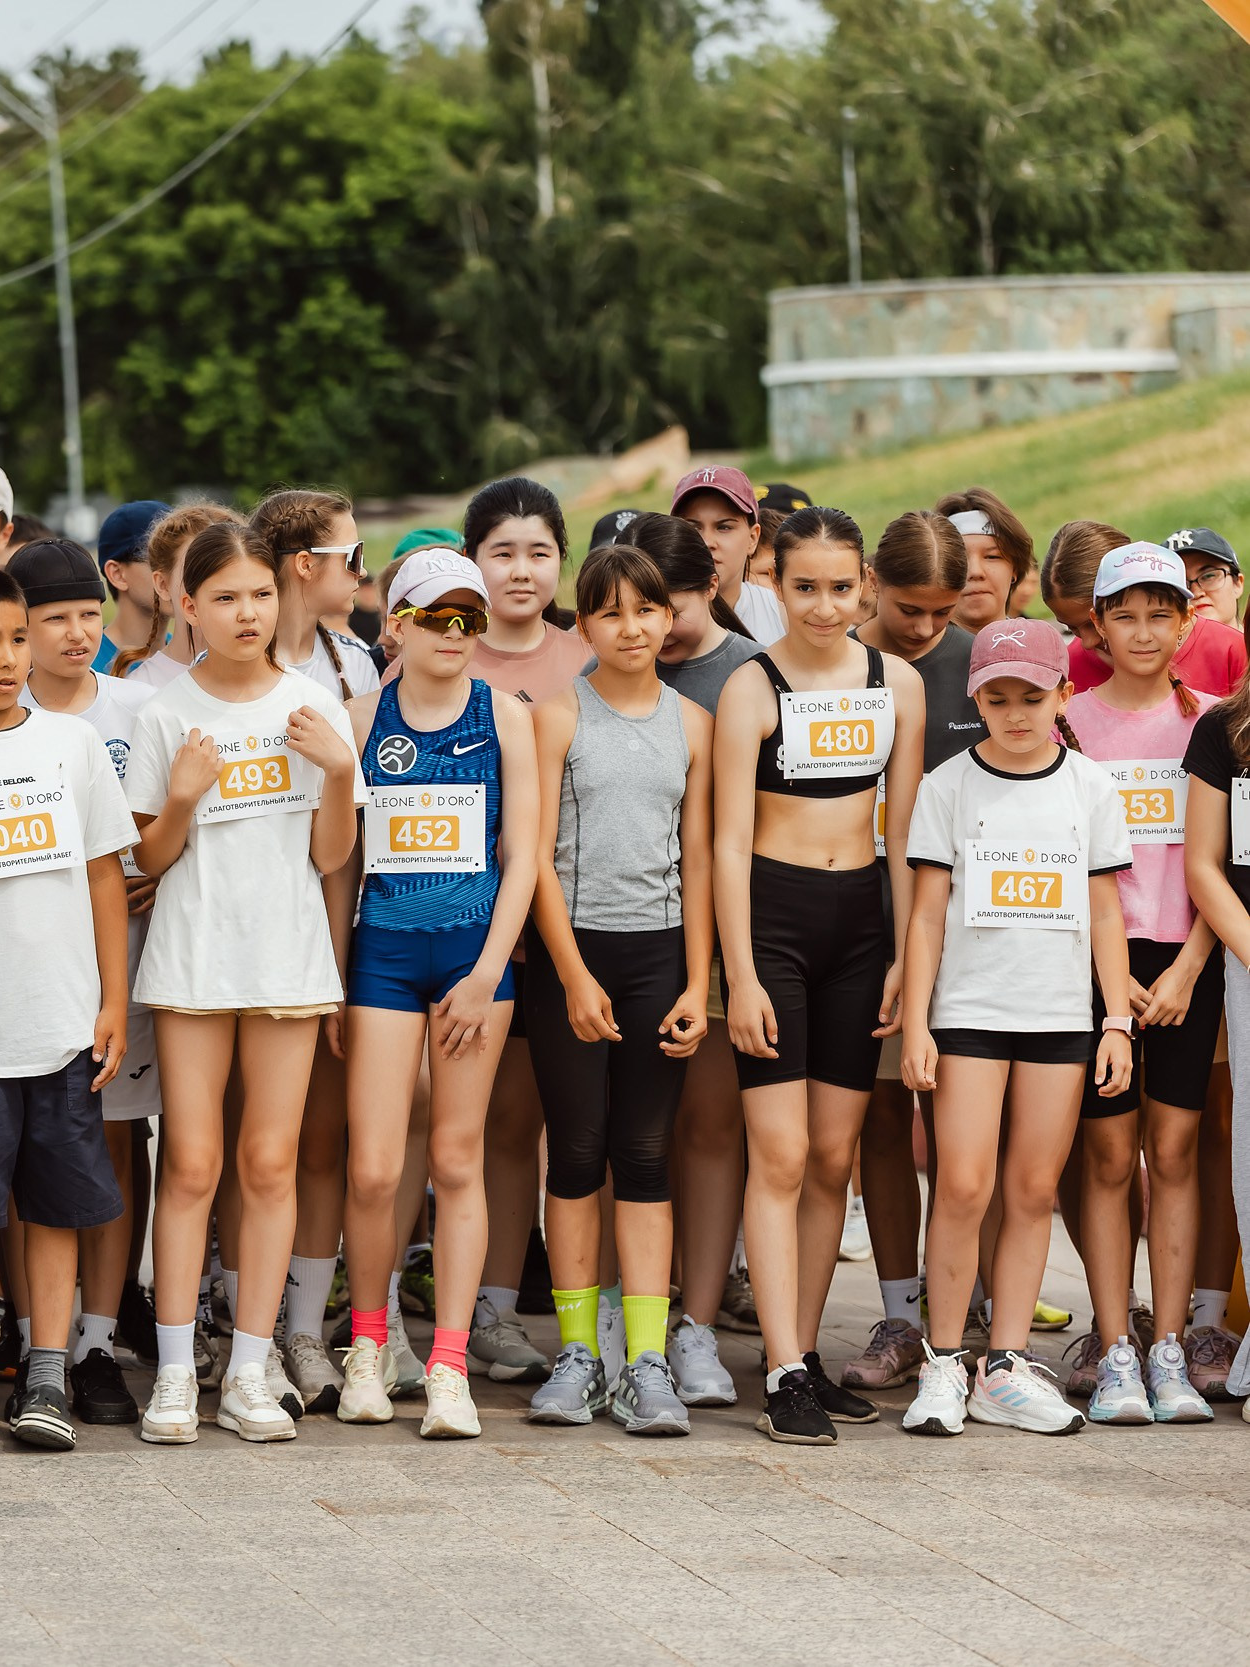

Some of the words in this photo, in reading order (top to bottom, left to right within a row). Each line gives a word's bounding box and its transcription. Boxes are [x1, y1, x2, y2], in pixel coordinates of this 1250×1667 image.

[792, 702, 834, 713] LEONE
[855, 699, 886, 711] D'ORO
[816, 724, 869, 752] 480
[226, 761, 283, 793] 493
[27, 791, 63, 805] D'ORO
[208, 796, 285, 813] БЛАГОТВОРИТЕЛЬНЫЙ
[287, 794, 306, 802] ЗАБЕГ
[375, 797, 415, 808] LEONE
[437, 796, 475, 806] D'ORO
[395, 820, 452, 847] 452
[53, 851, 72, 860] ЗАБЕГ
[377, 855, 452, 864] БЛАГОТВОРИТЕЛЬНЫЙ
[976, 851, 1018, 862] LEONE
[1041, 853, 1078, 864] D'ORO
[998, 875, 1055, 903] 467
[977, 911, 1054, 920] БЛАГОТВОРИТЕЛЬНЫЙ
